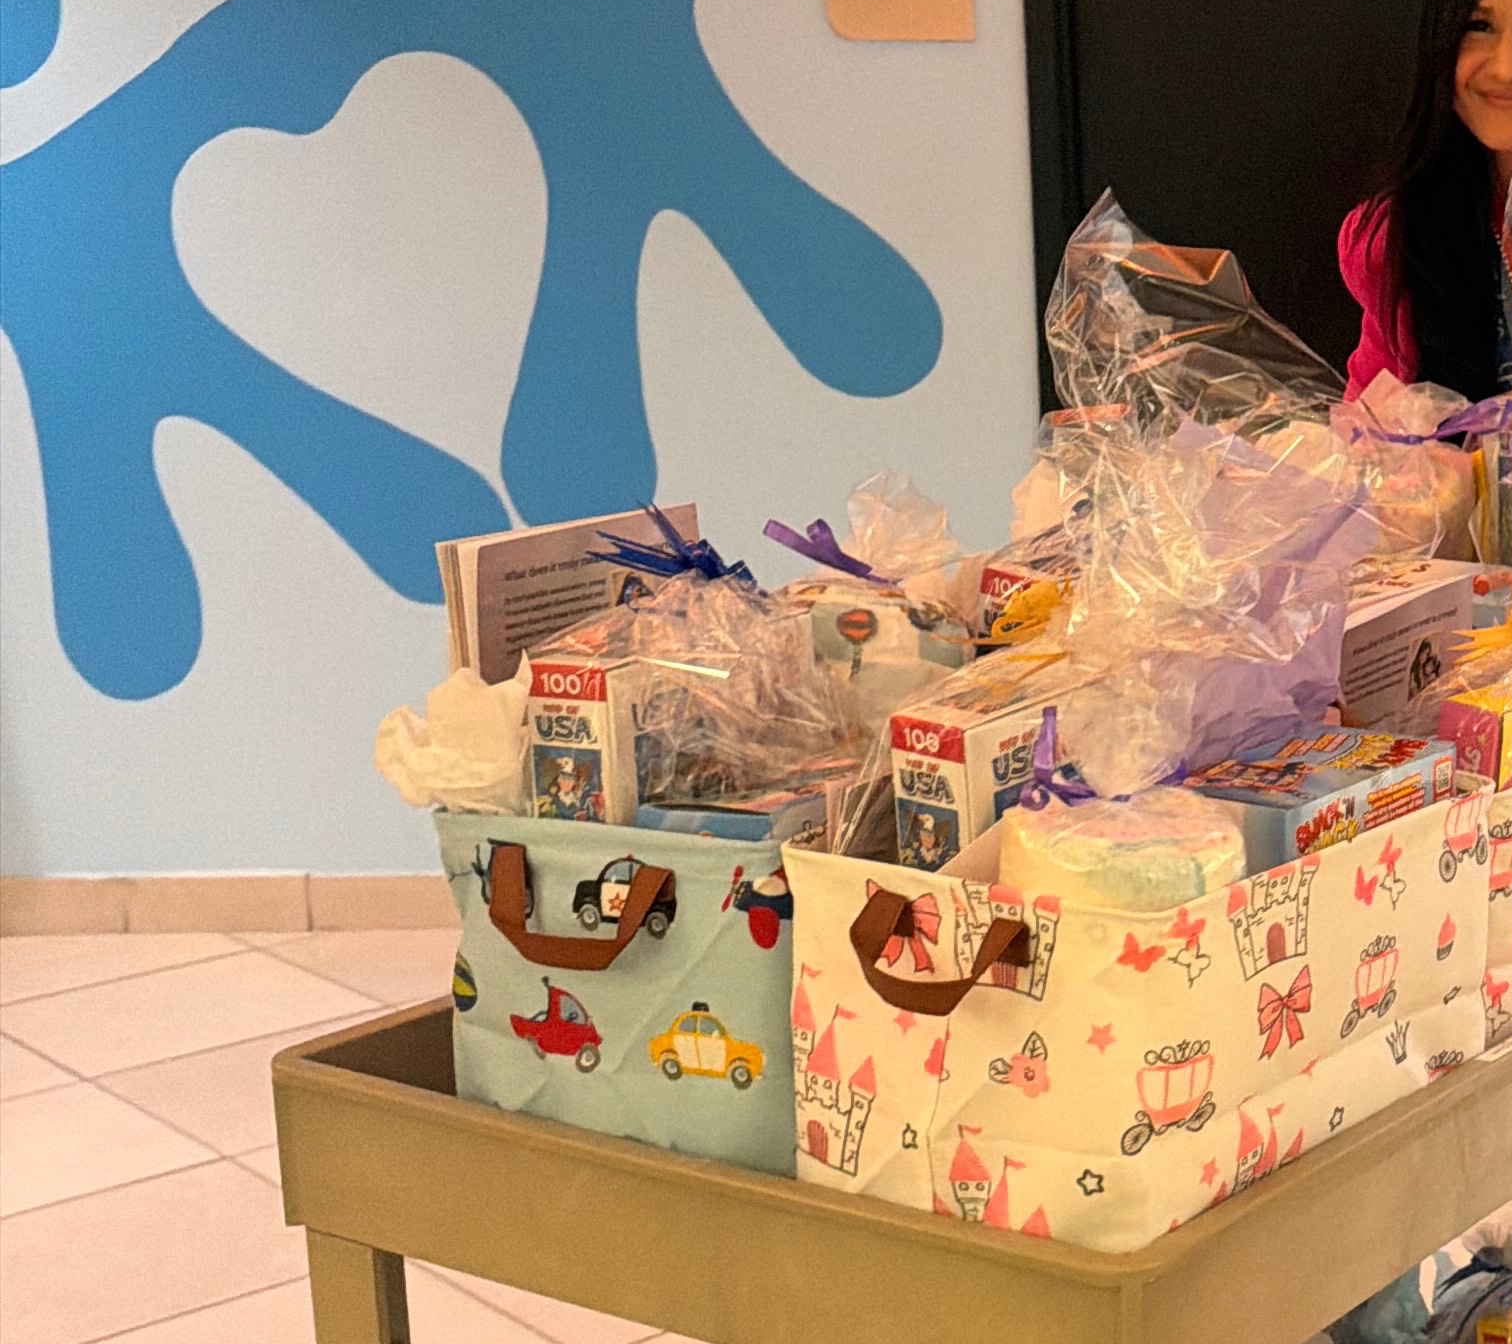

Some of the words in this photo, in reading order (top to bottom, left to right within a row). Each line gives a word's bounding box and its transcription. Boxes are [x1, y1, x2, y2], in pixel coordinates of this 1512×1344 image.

[540, 672, 582, 695] 100
[534, 715, 598, 744] USA
[992, 743, 1035, 786] US
[899, 767, 955, 805] USA
